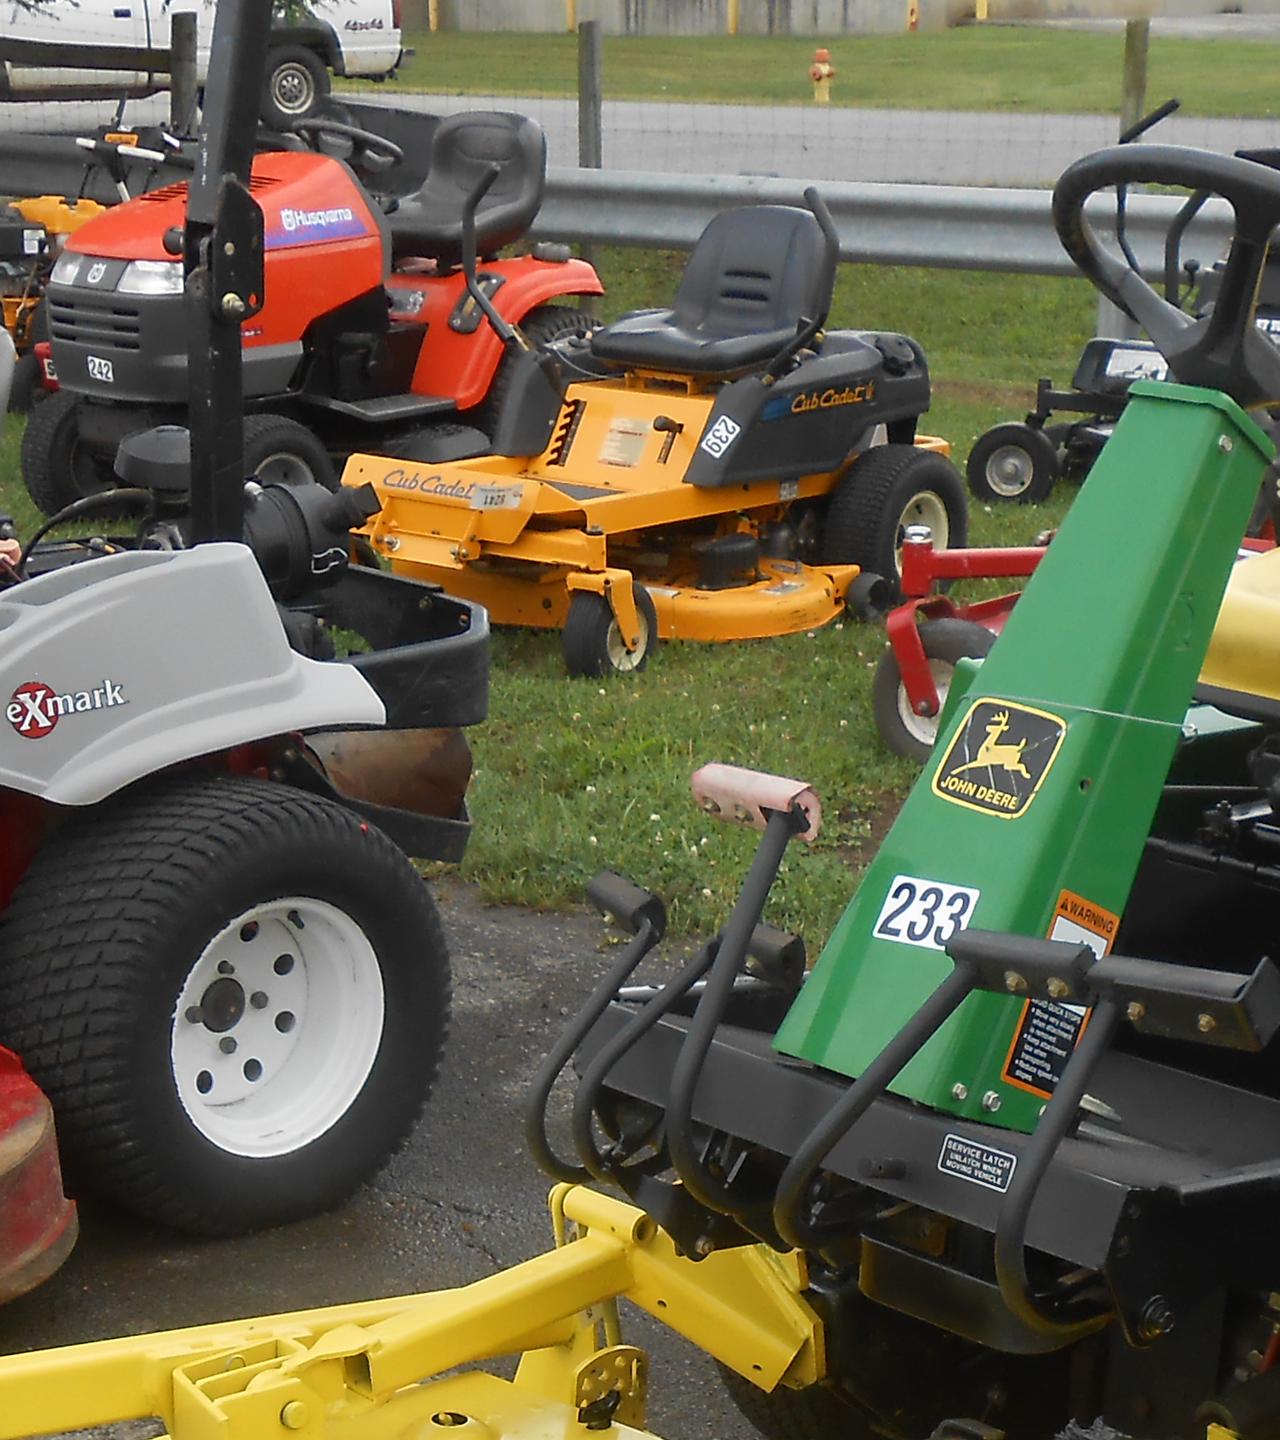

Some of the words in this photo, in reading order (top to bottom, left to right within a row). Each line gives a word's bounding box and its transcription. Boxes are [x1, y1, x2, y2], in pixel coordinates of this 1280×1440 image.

[294, 207, 353, 226] Husqvarna
[89, 359, 111, 380] 242
[791, 394, 819, 412] Cub
[820, 386, 867, 407] Cadet
[705, 417, 737, 454] 239
[383, 470, 419, 490] Cub
[420, 476, 476, 499] Cadet
[940, 776, 977, 797] JOHN
[976, 786, 1018, 810] DEERE
[878, 882, 970, 946] 233
[1070, 901, 1114, 934] WARNING
[947, 1140, 982, 1160] SERVICE
[982, 1152, 1010, 1169] LATCH
[946, 1160, 972, 1174] MOVING
[974, 1169, 1002, 1185] VEHICLE
